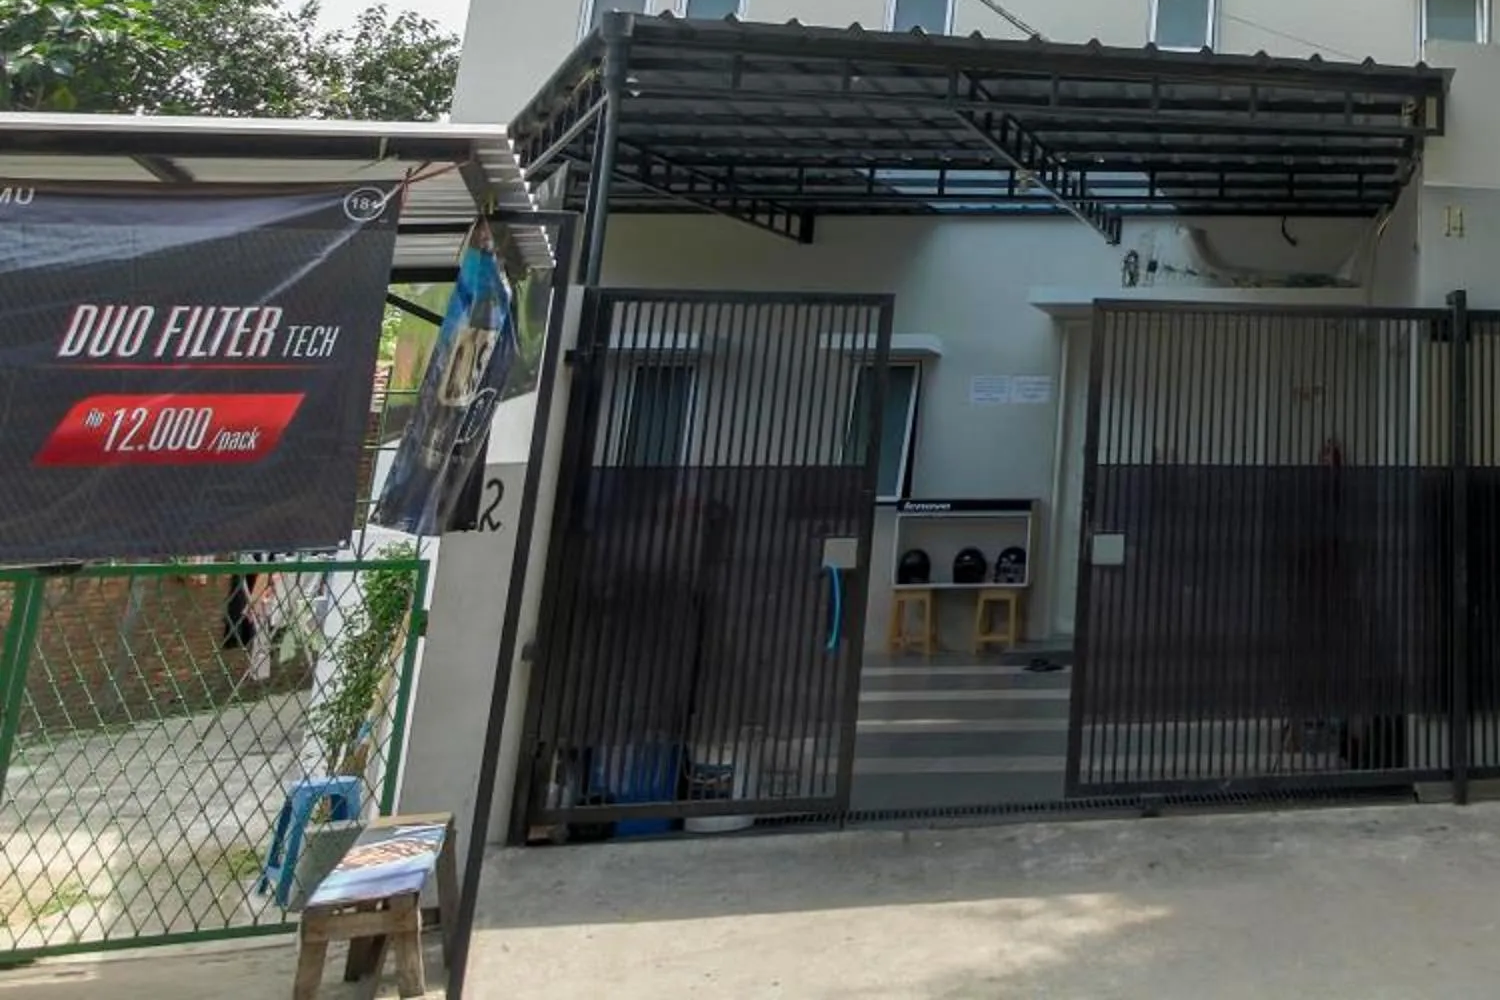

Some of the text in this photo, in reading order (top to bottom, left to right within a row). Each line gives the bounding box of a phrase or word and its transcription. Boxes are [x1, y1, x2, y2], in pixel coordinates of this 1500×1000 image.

[57, 303, 340, 358] DUO FILTER TECH
[104, 407, 214, 453] 12.000
[208, 427, 260, 455] /pack
